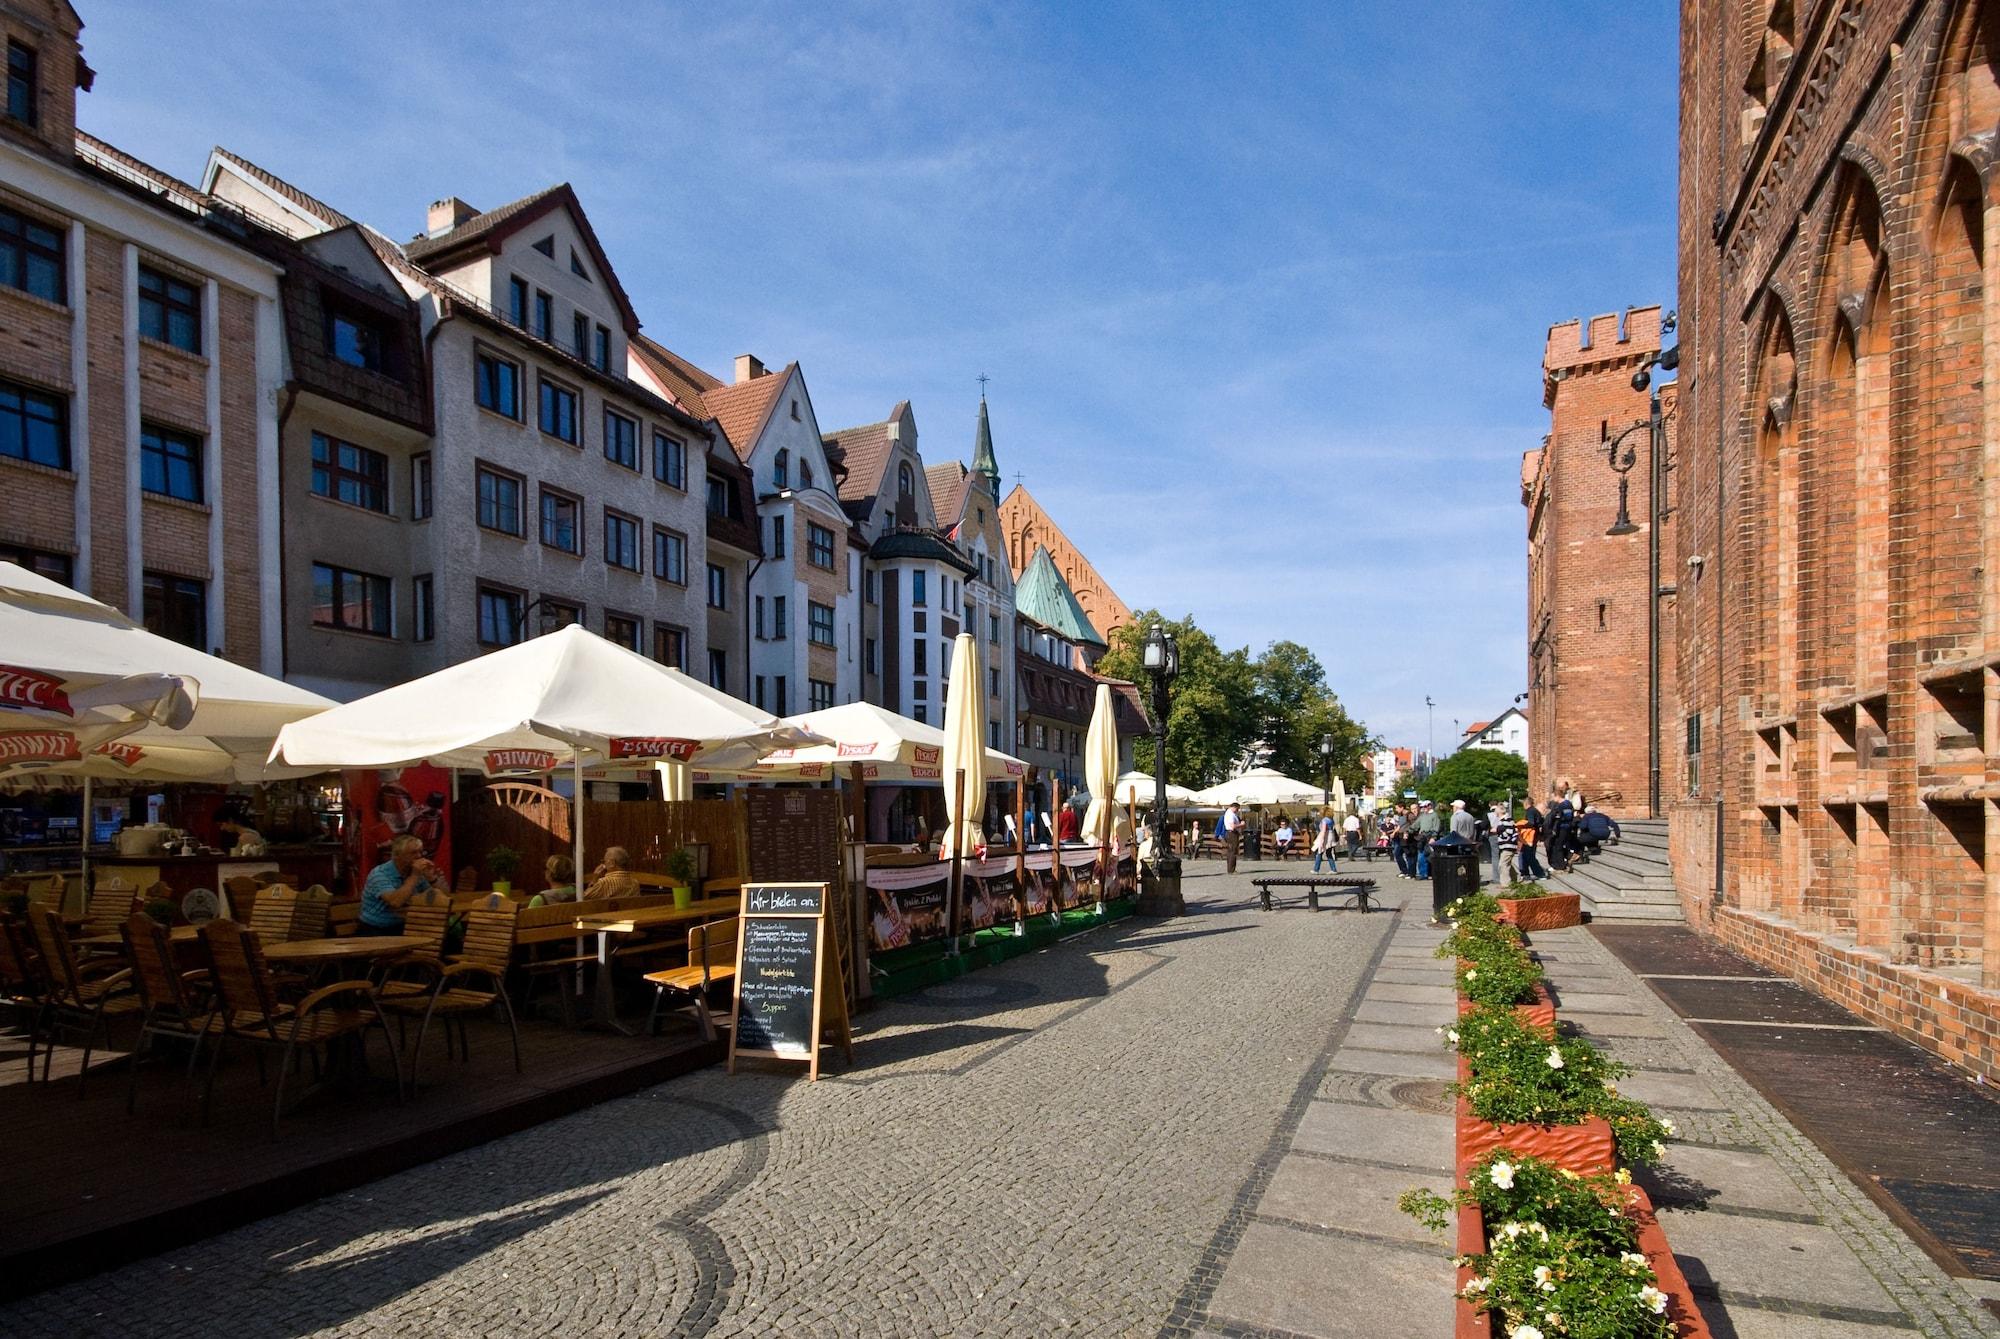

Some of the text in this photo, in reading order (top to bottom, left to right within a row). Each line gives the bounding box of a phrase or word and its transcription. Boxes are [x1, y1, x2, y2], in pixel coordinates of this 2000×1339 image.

[0, 671, 50, 705] IEC
[840, 743, 876, 756] TYSKIE
[916, 748, 938, 763] TYSKIE
[750, 888, 768, 911] Wir
[770, 890, 797, 910] bieten
